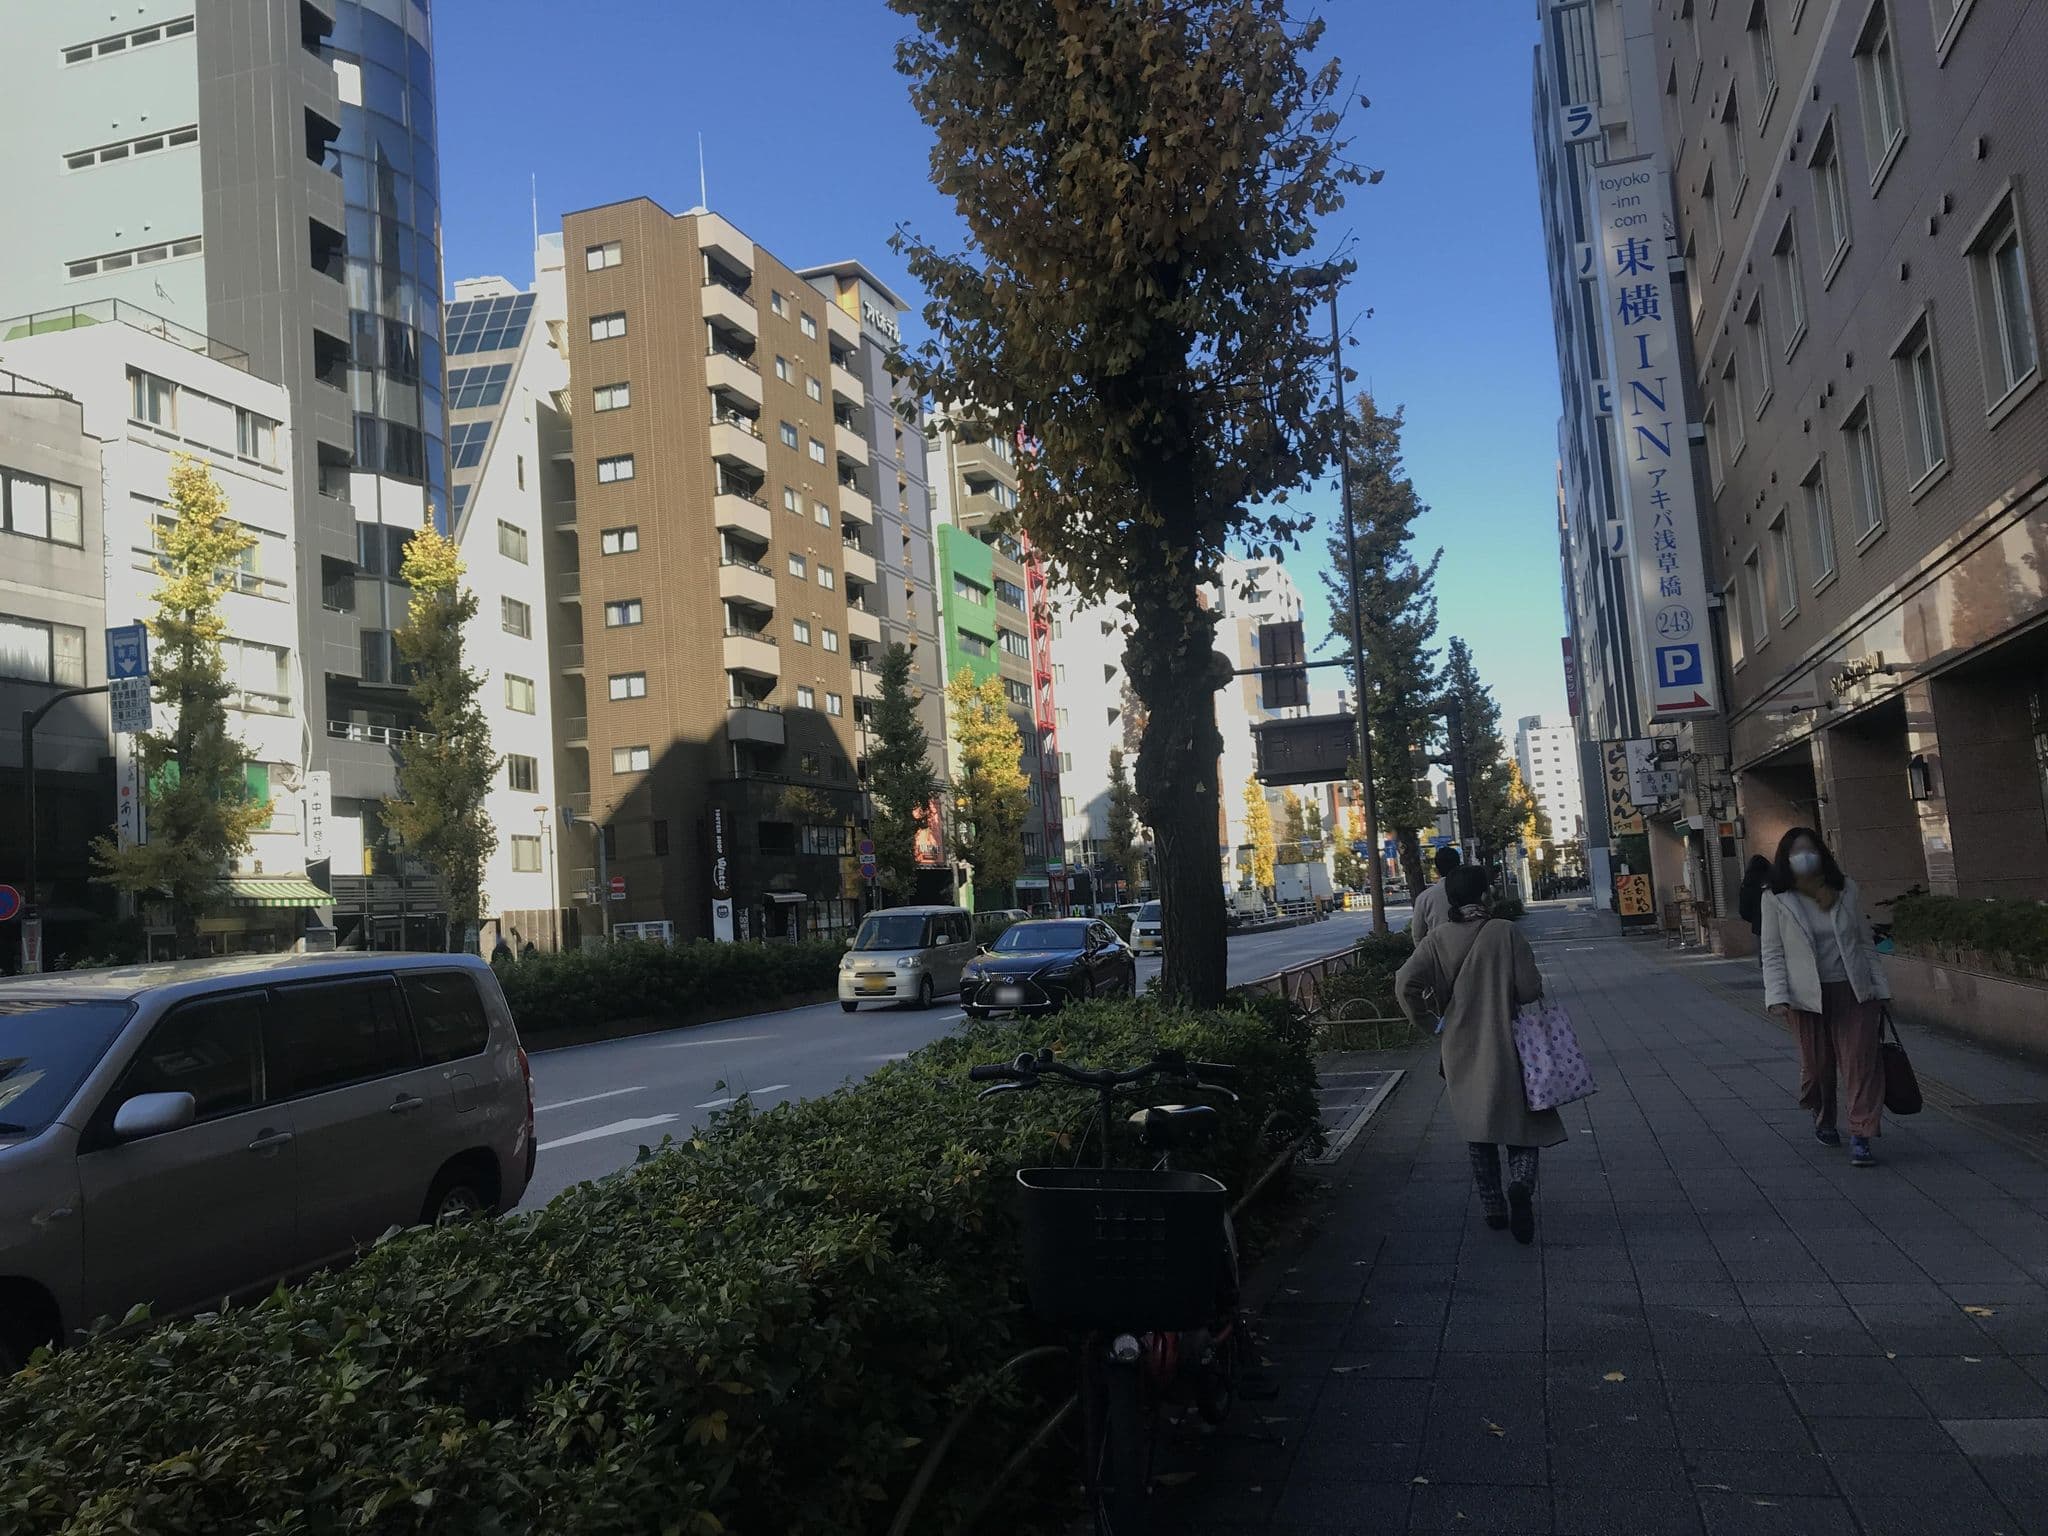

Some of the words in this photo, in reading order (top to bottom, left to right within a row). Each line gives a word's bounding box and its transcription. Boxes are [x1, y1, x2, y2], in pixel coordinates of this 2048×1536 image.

[1600, 172, 1650, 192] toyoko
[1611, 195, 1640, 209] -inn
[1610, 212, 1647, 229] .com
[864, 301, 901, 343] アパホテル
[1647, 469, 1682, 598] アキバ浅草橋
[1659, 610, 1691, 633] 243
[1664, 649, 1693, 683] P
